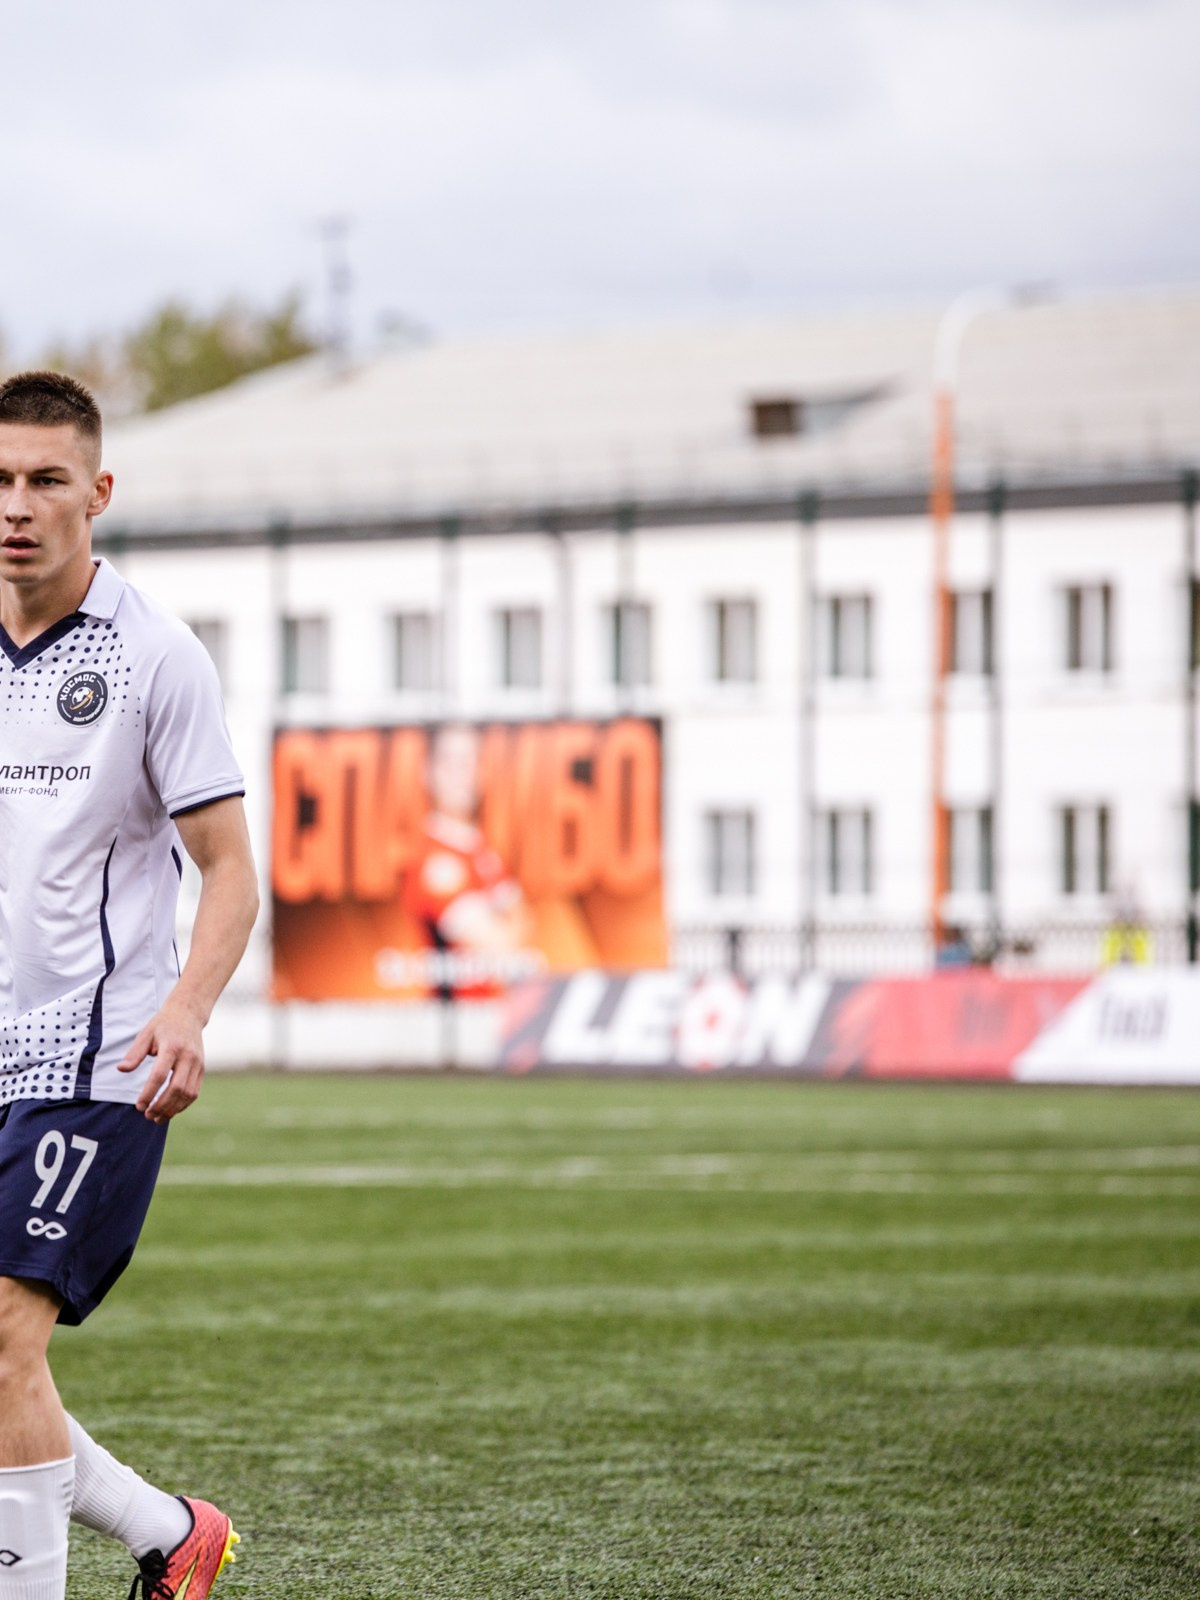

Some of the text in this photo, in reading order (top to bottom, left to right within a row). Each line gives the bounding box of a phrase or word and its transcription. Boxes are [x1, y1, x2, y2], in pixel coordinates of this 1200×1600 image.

[60, 674, 96, 700] КОСМОС
[274, 722, 661, 900] СПАИБО
[543, 970, 833, 1067] LEON
[30, 1130, 99, 1214] 97
